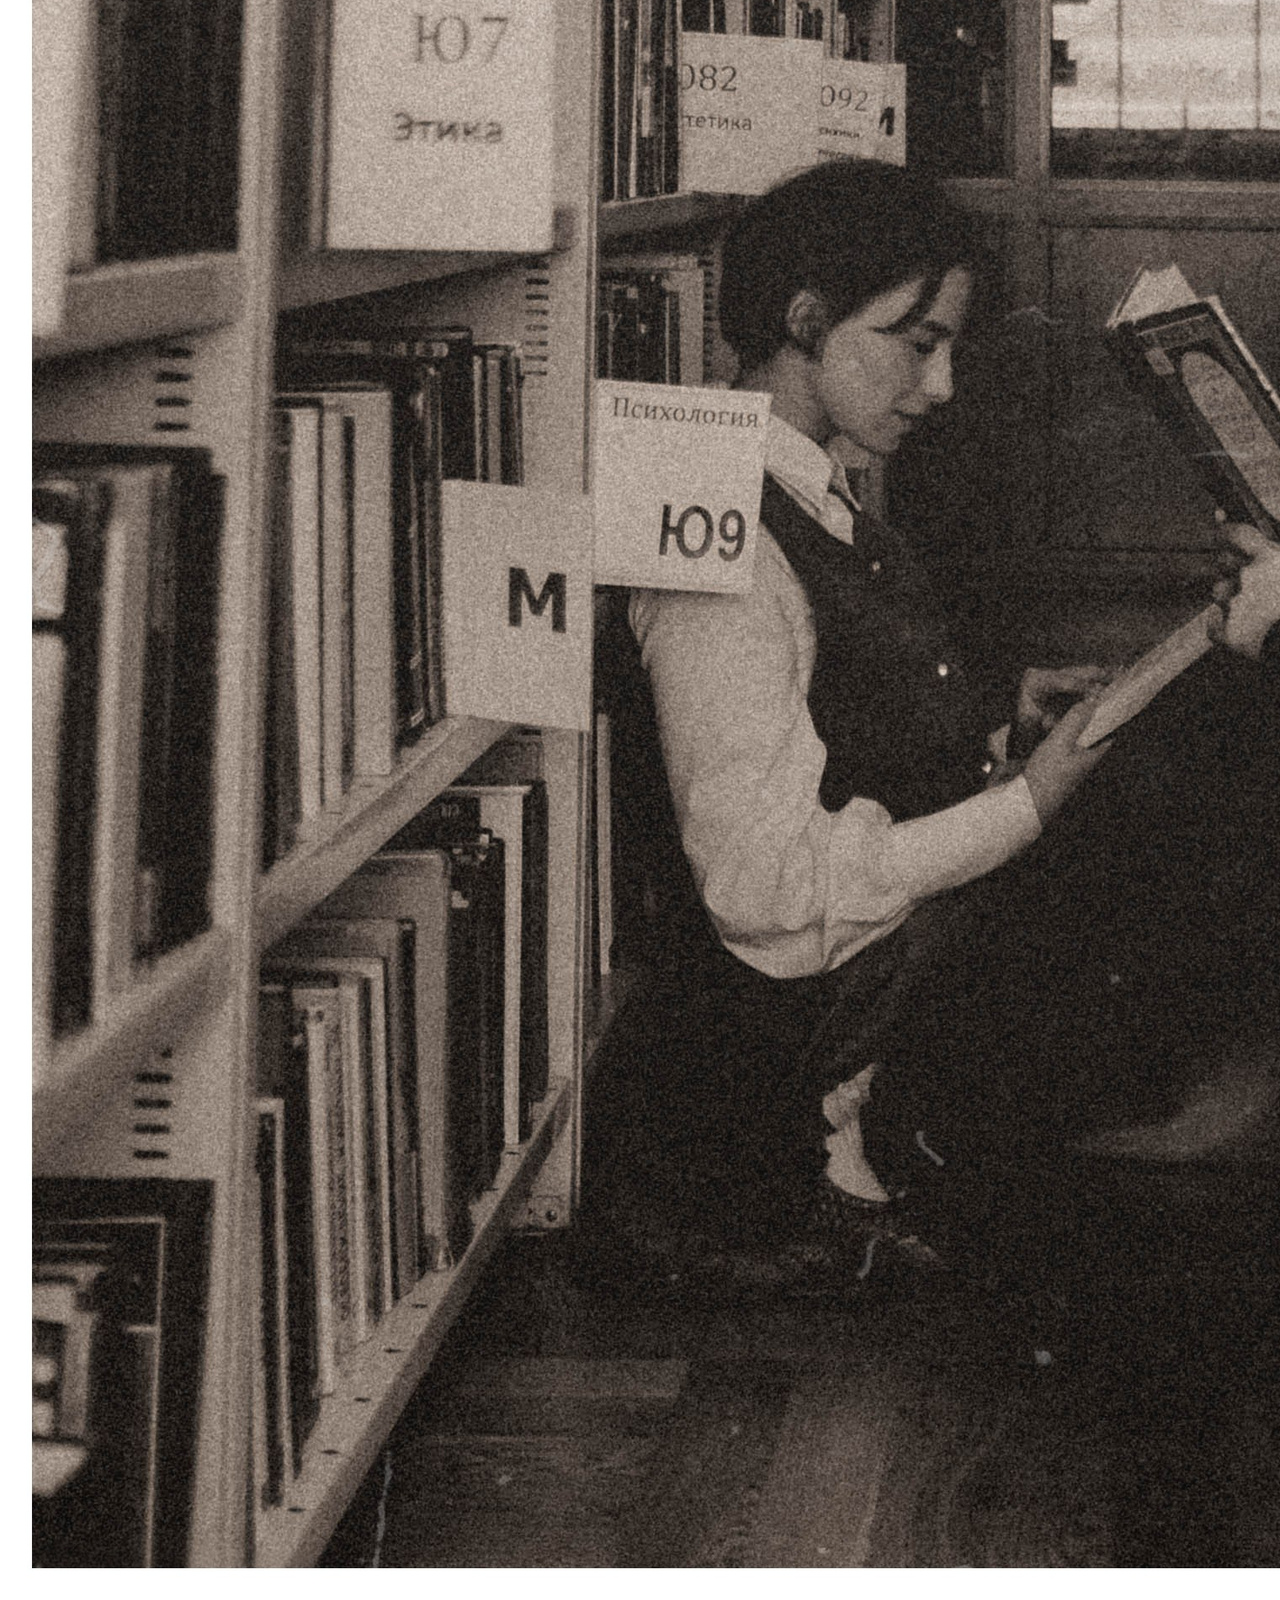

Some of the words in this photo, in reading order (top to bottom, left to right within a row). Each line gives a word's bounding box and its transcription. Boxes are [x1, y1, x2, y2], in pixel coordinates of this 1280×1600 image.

[411, 14, 509, 65] Ю7
[394, 111, 504, 144] Этика
[612, 397, 760, 430] Психология
[658, 503, 747, 562] Ю9
[508, 566, 567, 633] М
